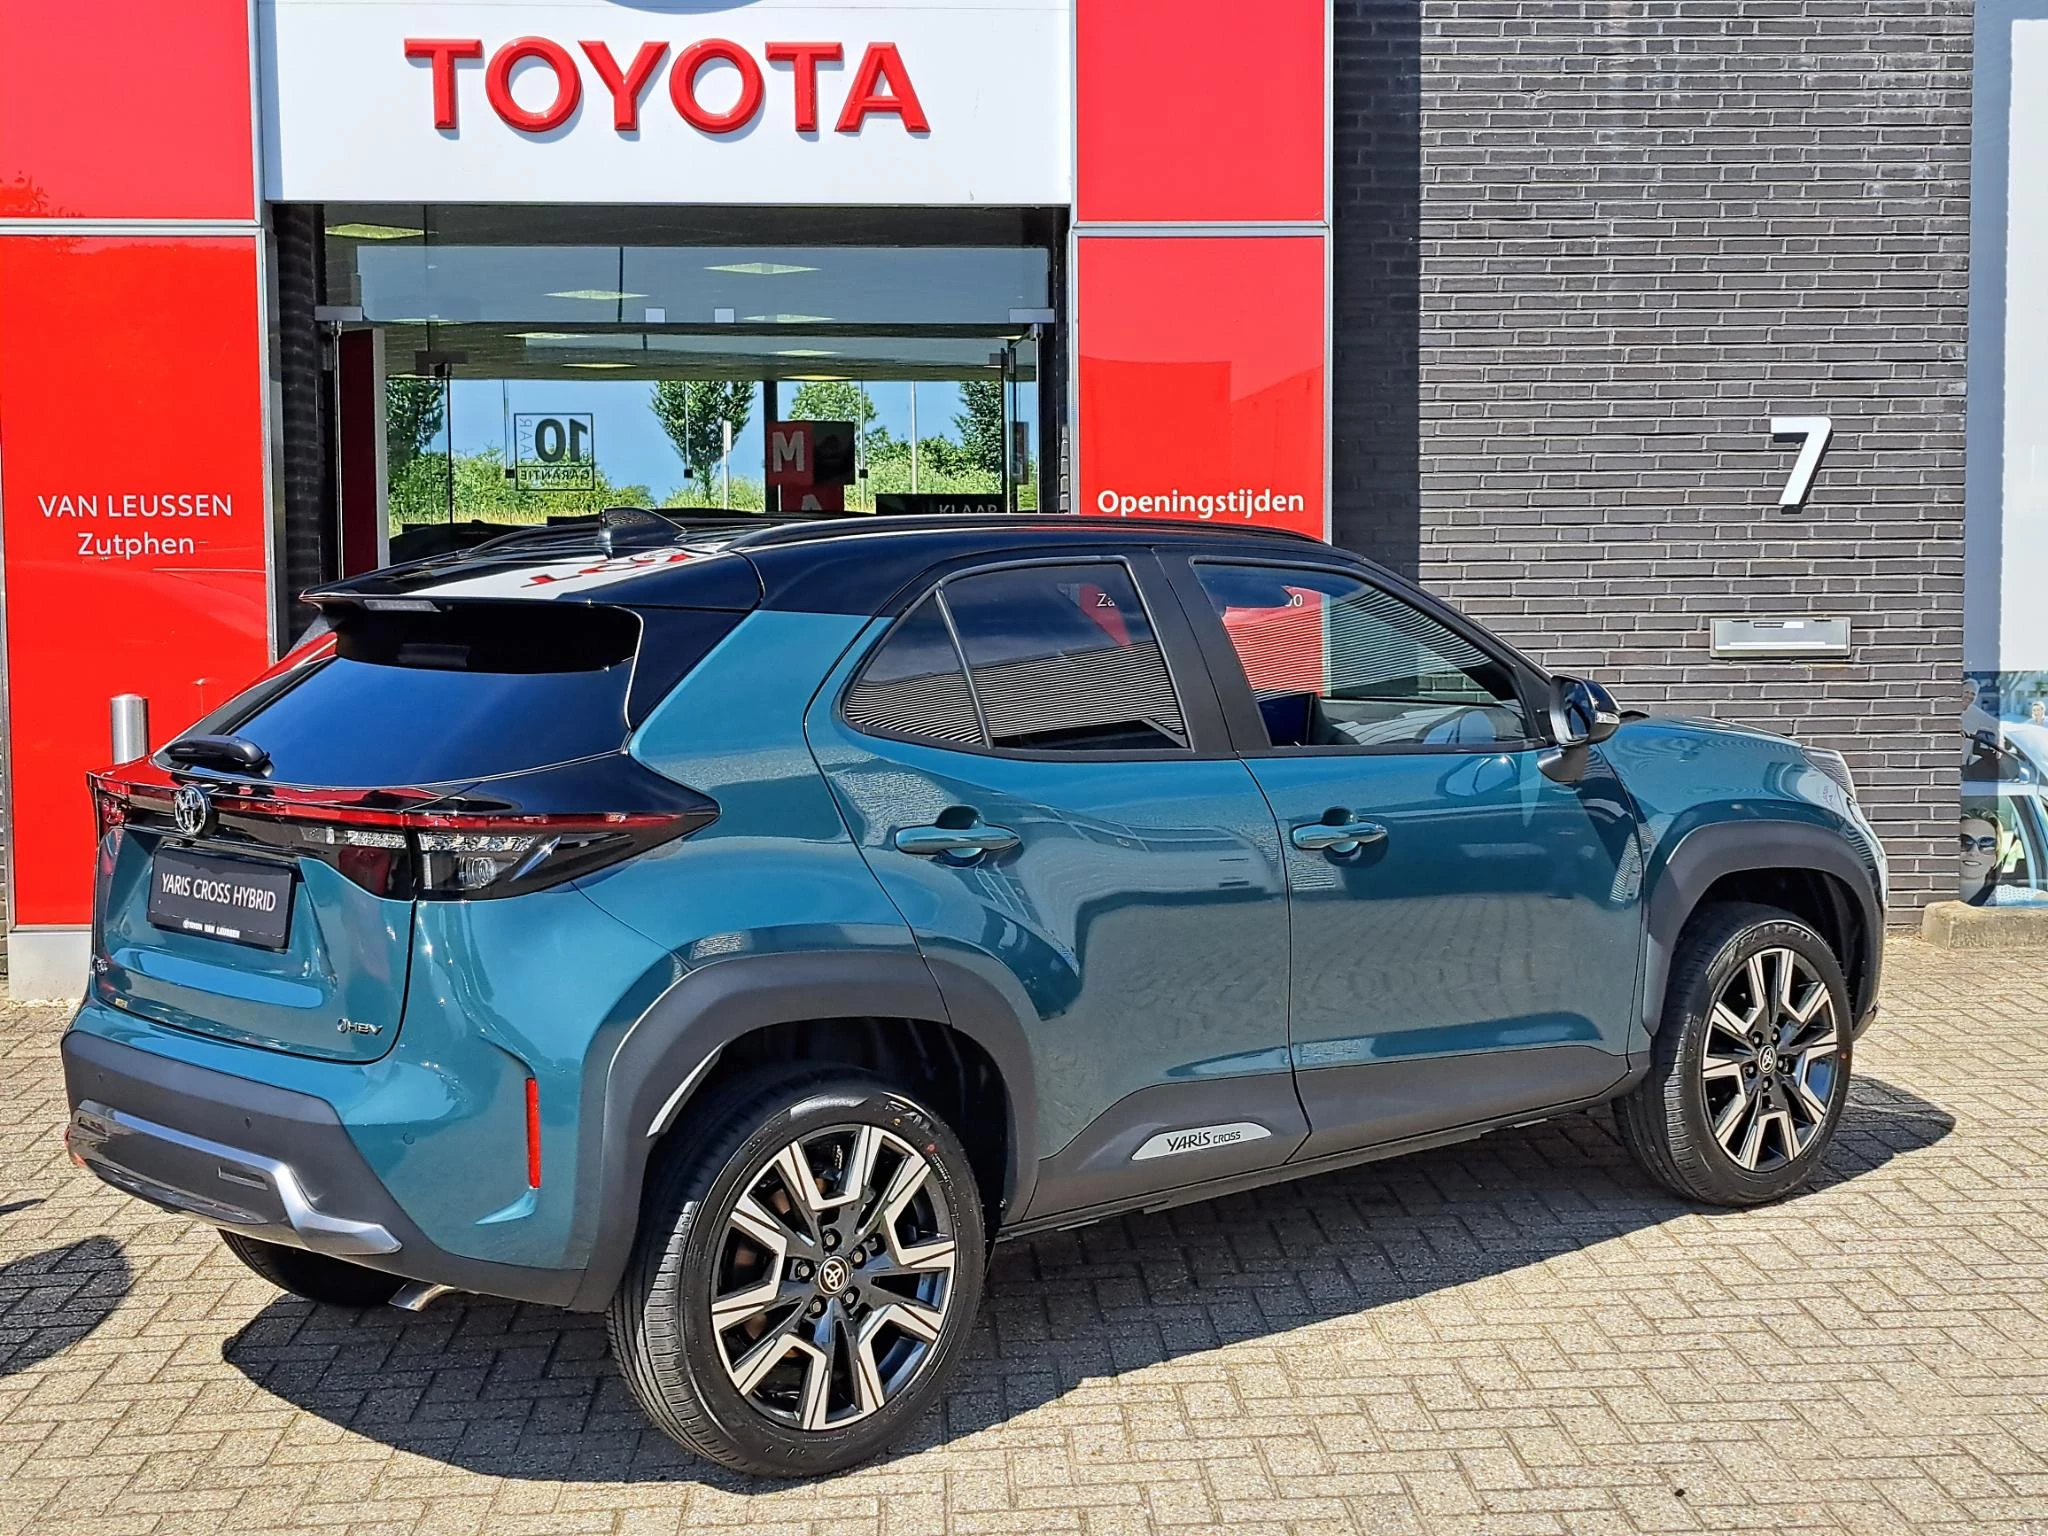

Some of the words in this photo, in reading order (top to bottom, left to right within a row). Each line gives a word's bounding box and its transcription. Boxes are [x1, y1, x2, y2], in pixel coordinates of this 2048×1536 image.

[404, 36, 931, 133] TOYOTA
[772, 431, 805, 472] M
[1770, 416, 1832, 506] 7
[38, 495, 98, 517] VAN
[107, 494, 232, 517] LEUSSEN
[1097, 489, 1304, 519] Openingstijden
[77, 531, 194, 560] Zutphen
[162, 872, 192, 897] YARIS
[193, 878, 231, 904] CROSS
[233, 885, 276, 912] HYBRID
[1213, 1131, 1241, 1145] CROSS
